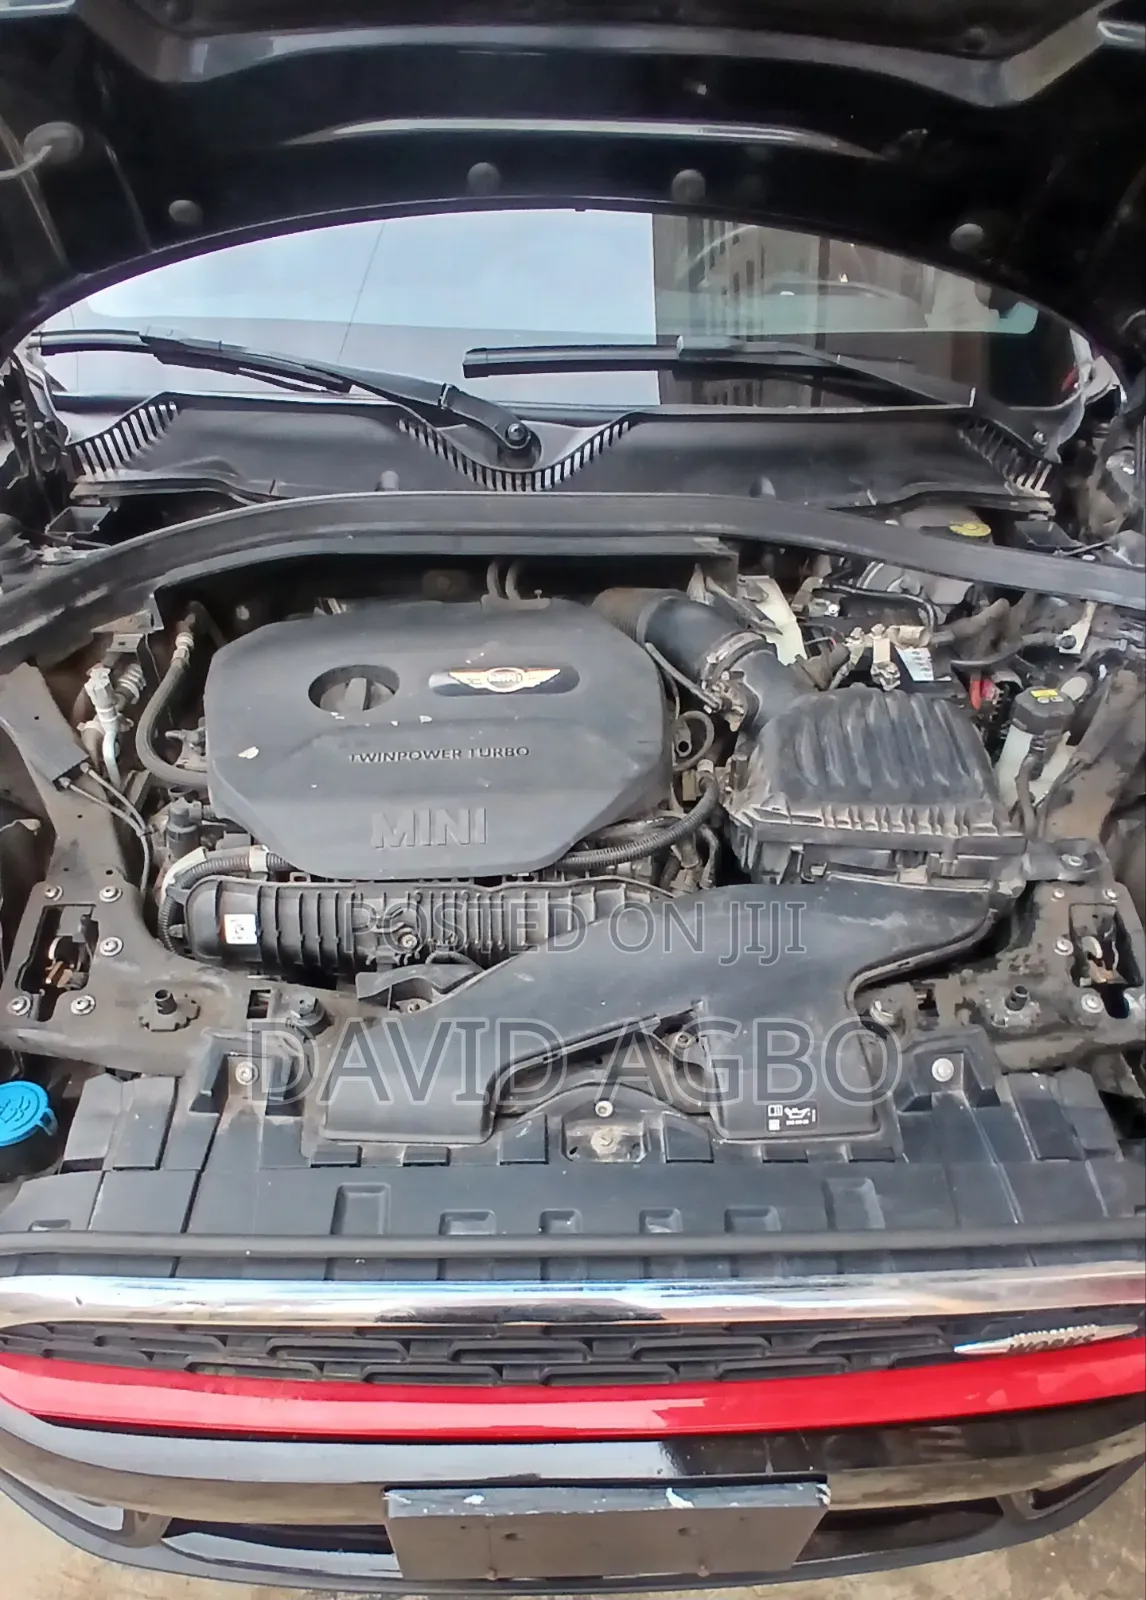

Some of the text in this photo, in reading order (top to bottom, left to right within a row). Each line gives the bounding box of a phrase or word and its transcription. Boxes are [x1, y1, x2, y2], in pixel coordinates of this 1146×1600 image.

[350, 746, 530, 763] TWINPOWER TURBO
[371, 807, 488, 850] MINI
